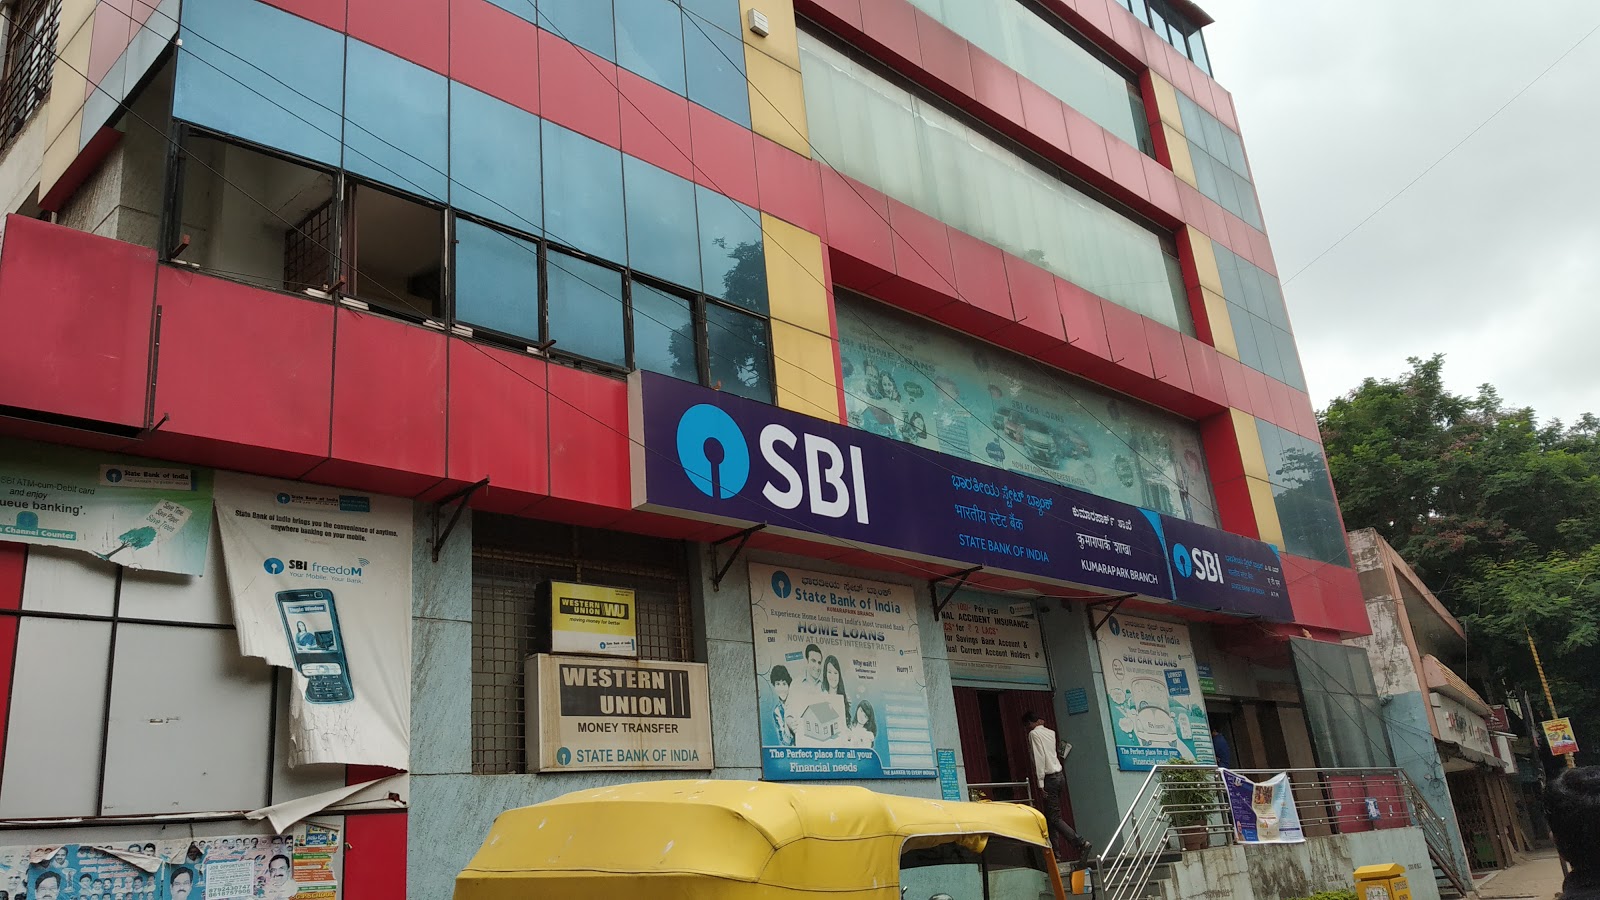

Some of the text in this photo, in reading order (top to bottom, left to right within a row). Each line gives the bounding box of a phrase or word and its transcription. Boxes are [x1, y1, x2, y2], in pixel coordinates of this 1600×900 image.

[859, 343, 894, 358] HOME
[1012, 400, 1023, 410] SBI
[1026, 405, 1039, 415] CAR
[760, 424, 870, 525] SBI
[16, 478, 78, 493] ATM-cum-Debit
[78, 487, 96, 495] card
[951, 474, 1000, 498] ಭಾರತೀಯ
[1002, 485, 1025, 509] ಸ್ಟೇಟ್
[10, 488, 48, 500] and enjoy
[156, 509, 167, 518] Save
[163, 502, 175, 512] Save
[146, 515, 161, 526] Save
[235, 510, 251, 518] State
[252, 512, 268, 520] Bank
[276, 515, 291, 523] India
[293, 516, 310, 526] brings
[334, 523, 368, 533] convenience
[954, 504, 987, 524] भारतीय
[988, 509, 1008, 528] स्टेट
[5, 526, 75, 539] Channel Counter
[271, 524, 300, 533] anywhere
[301, 527, 323, 537] banking
[346, 533, 367, 542] mobile.
[959, 534, 1050, 562] STATE BANK OF INDIA
[1113, 542, 1132, 556] शाखा
[288, 560, 362, 576] SBI freedoM
[1081, 559, 1159, 584] KUMARAPARK BRANCH
[1192, 548, 1224, 584] SBI
[306, 573, 328, 581] Mobile.
[802, 577, 841, 590] ಭಾರತೀಯ
[562, 599, 600, 609] WESTERN
[796, 588, 901, 614] State Bank of India
[574, 603, 625, 618] UNION WU
[826, 607, 856, 615] KUMARAPARK
[974, 605, 999, 615] Per year
[770, 609, 801, 620] Experience
[801, 613, 817, 621] Home
[831, 616, 844, 624] from
[844, 617, 862, 626] India's
[875, 622, 893, 630] trusted
[958, 613, 990, 624] ACCIDENT
[994, 618, 1029, 629] INSURANCE
[798, 623, 885, 642] HOME LOANS
[956, 624, 964, 632] for
[787, 634, 895, 651] NOW AT LOWEST INTEREST RATES
[956, 634, 978, 646] Savings
[982, 637, 995, 645] Bank
[998, 639, 1020, 648] Account
[1122, 629, 1180, 645] State Bank of India
[960, 646, 1030, 660] Current Account Holders
[853, 660, 862, 668] Why
[1123, 655, 1178, 668] SBI CAR LOANS
[896, 666, 908, 674] Hurry
[562, 668, 665, 690] WESTERN
[600, 696, 666, 716] UNION
[578, 722, 679, 734] MONEY TRANSFER
[577, 750, 700, 762] STATE BANK OF INDIA
[770, 749, 873, 761] The Perfect place for all your
[1133, 758, 1155, 766] Financial
[790, 762, 858, 772] Financial needs
